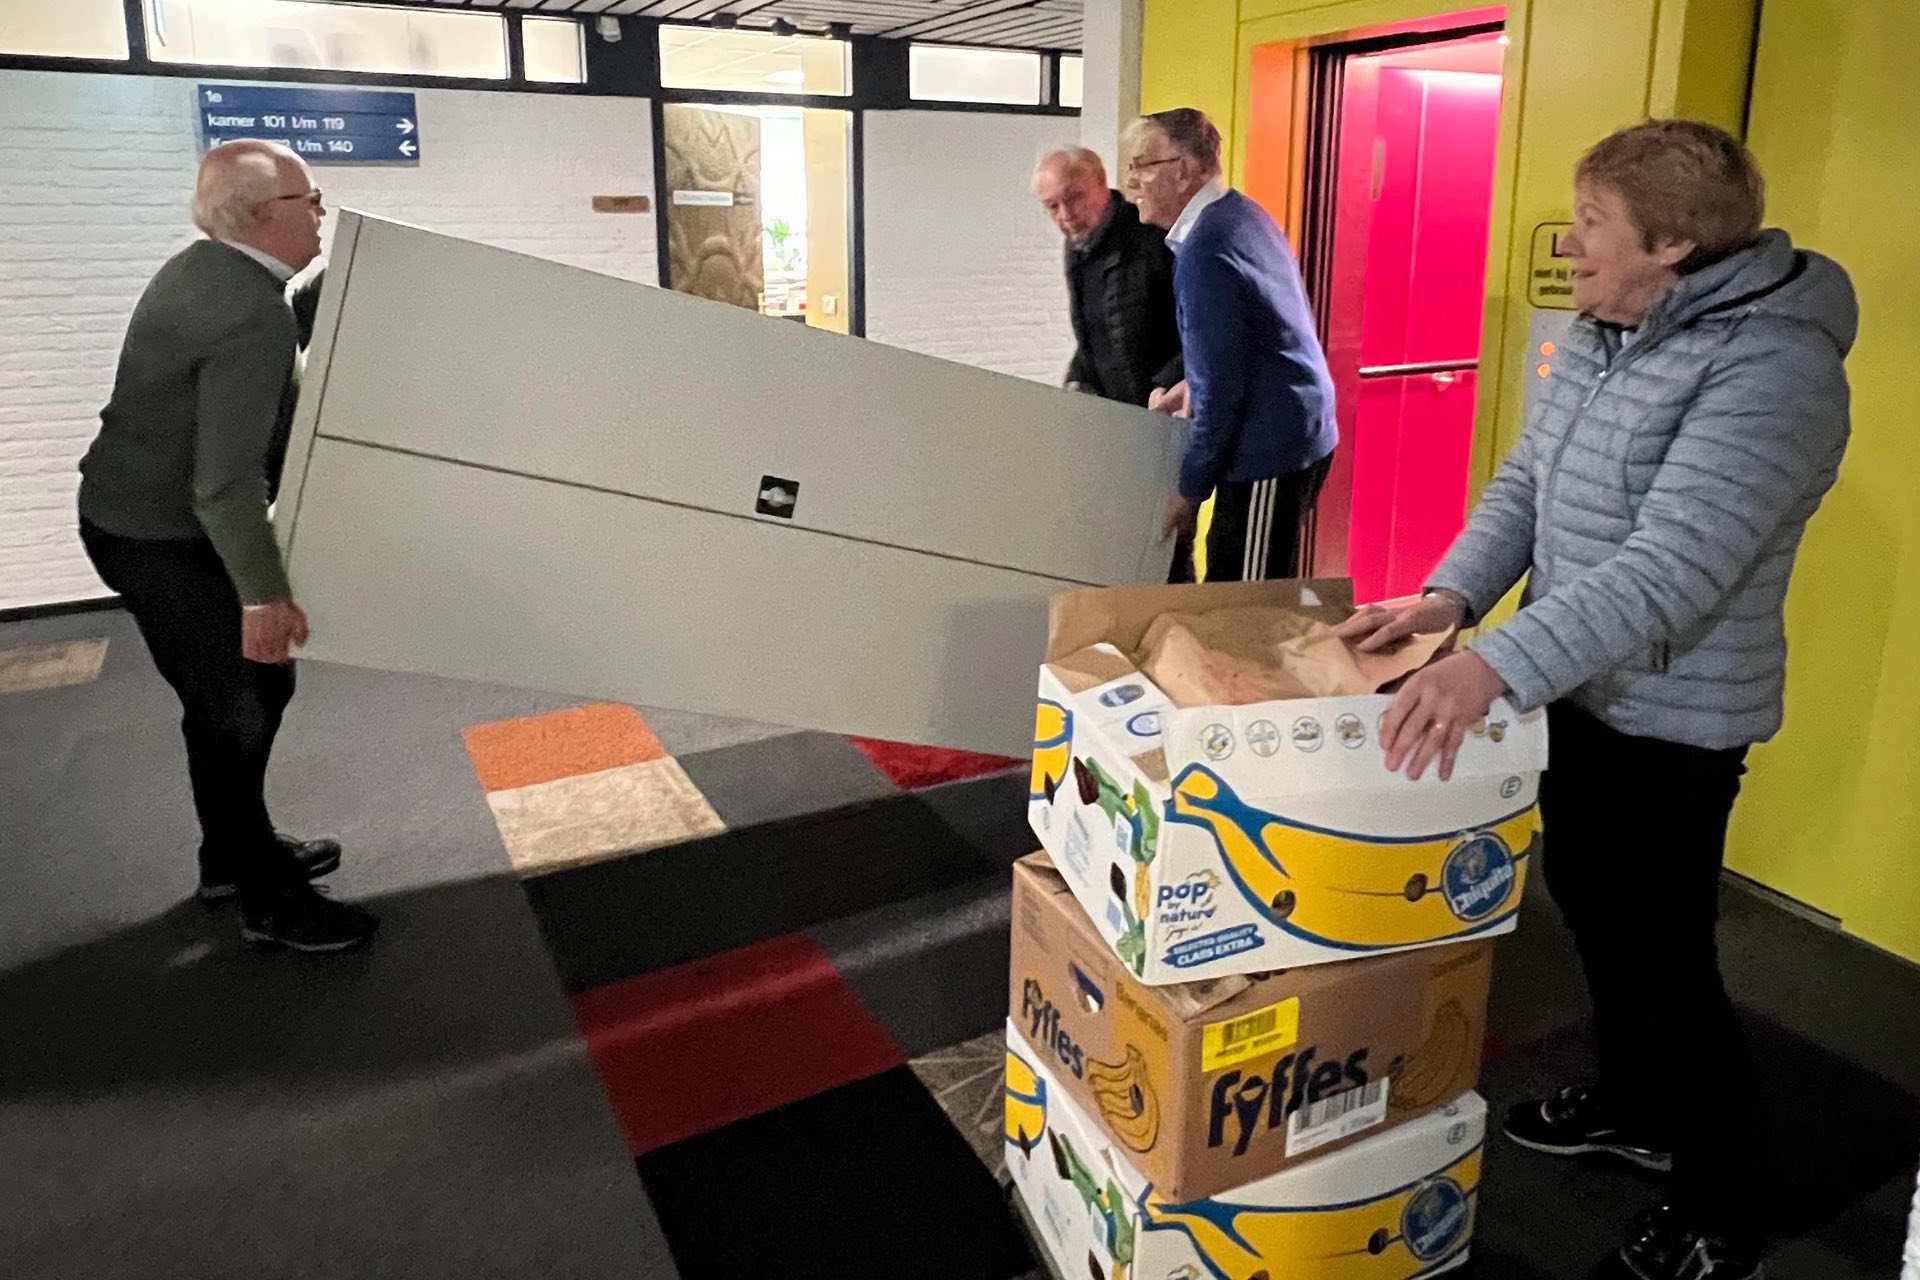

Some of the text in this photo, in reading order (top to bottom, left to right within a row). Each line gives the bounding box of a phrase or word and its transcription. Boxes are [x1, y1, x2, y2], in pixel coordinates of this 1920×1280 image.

[205, 90, 223, 103] 1e
[207, 114, 345, 130] kamer 101 t/m 119
[297, 140, 322, 153] t/m
[328, 141, 353, 153] 140
[1158, 883, 1208, 907] pop
[1176, 936, 1254, 967] CLASS EXTRA
[1208, 1045, 1370, 1157] fyffes
